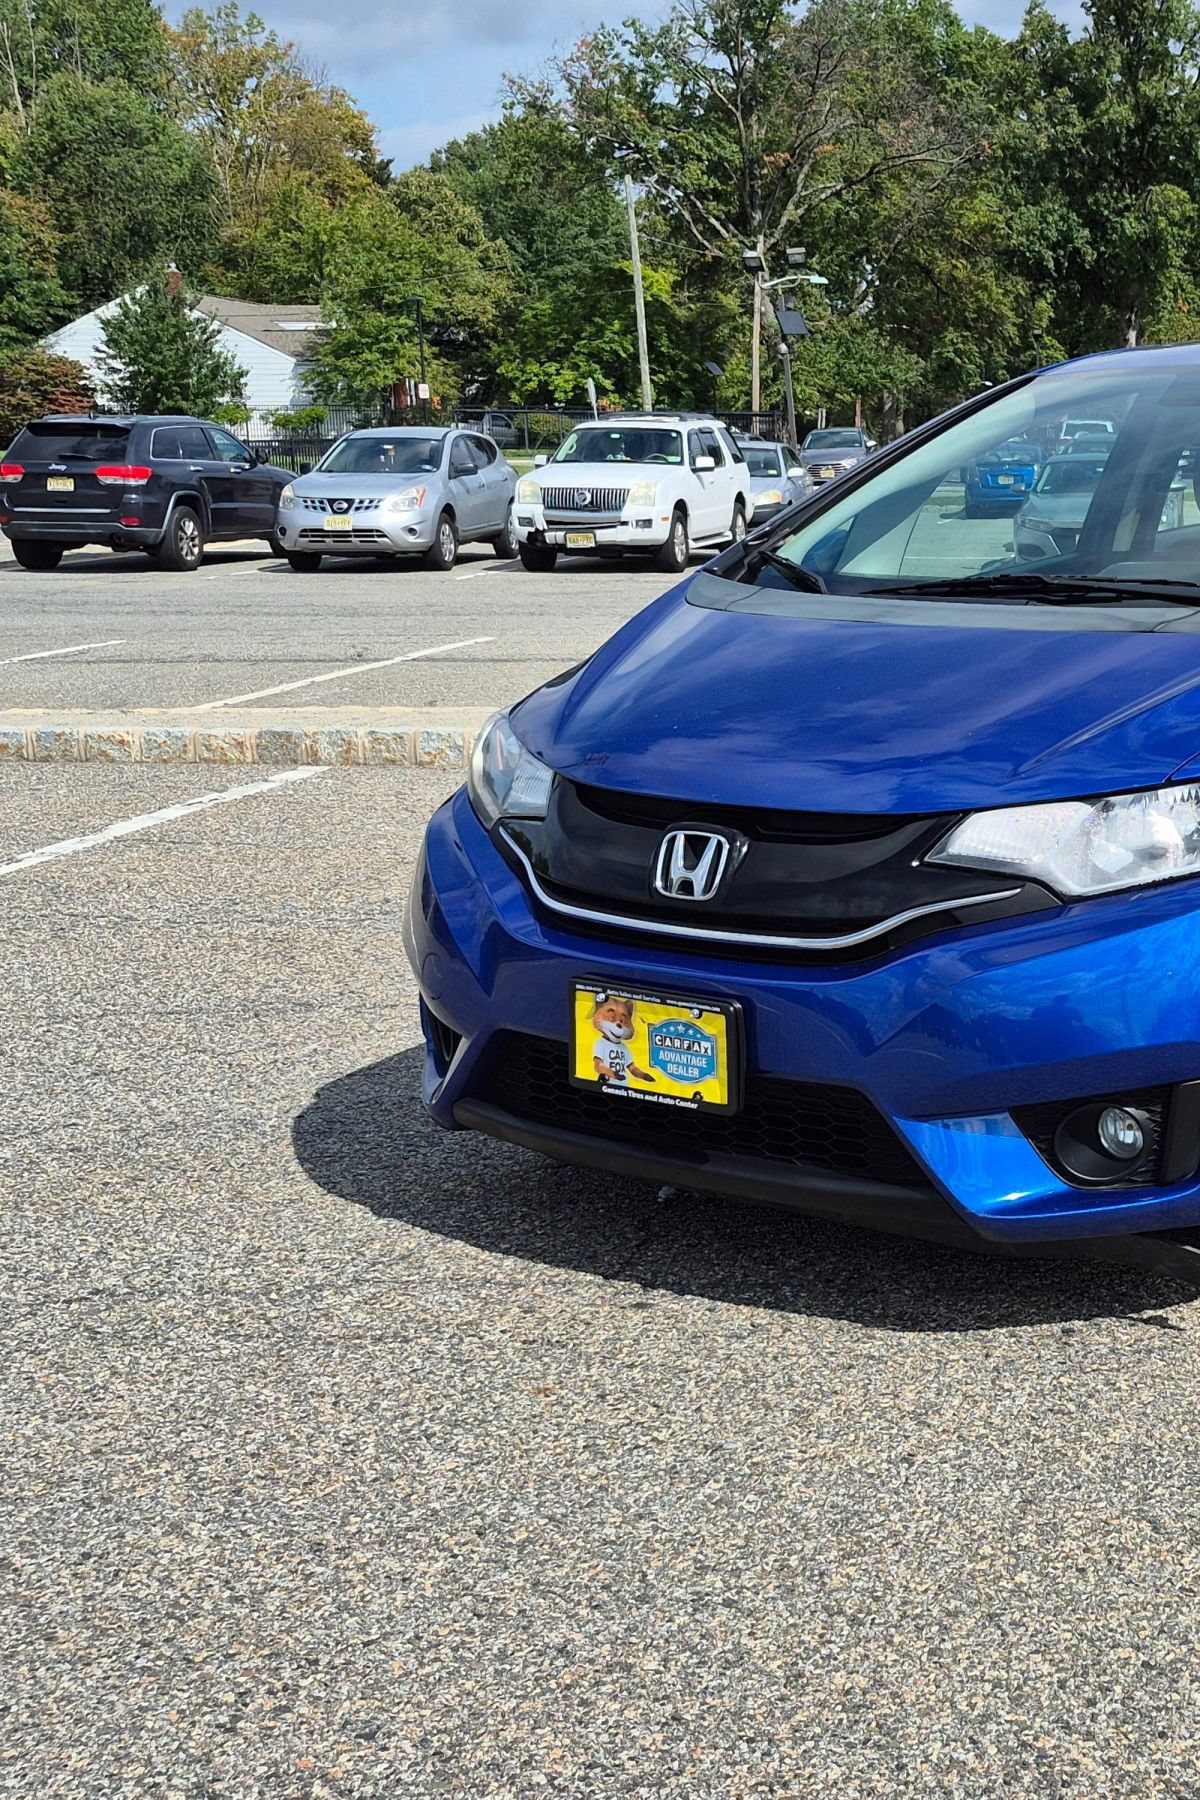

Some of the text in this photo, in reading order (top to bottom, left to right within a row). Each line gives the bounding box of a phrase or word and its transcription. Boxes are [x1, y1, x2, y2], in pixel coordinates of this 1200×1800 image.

[654, 1034, 711, 1056] CARFAX
[658, 1050, 708, 1068] ADVANTAGE
[667, 1062, 699, 1078] DEALER
[602, 1085, 698, 1109] Genesis Tires and Auto Center
